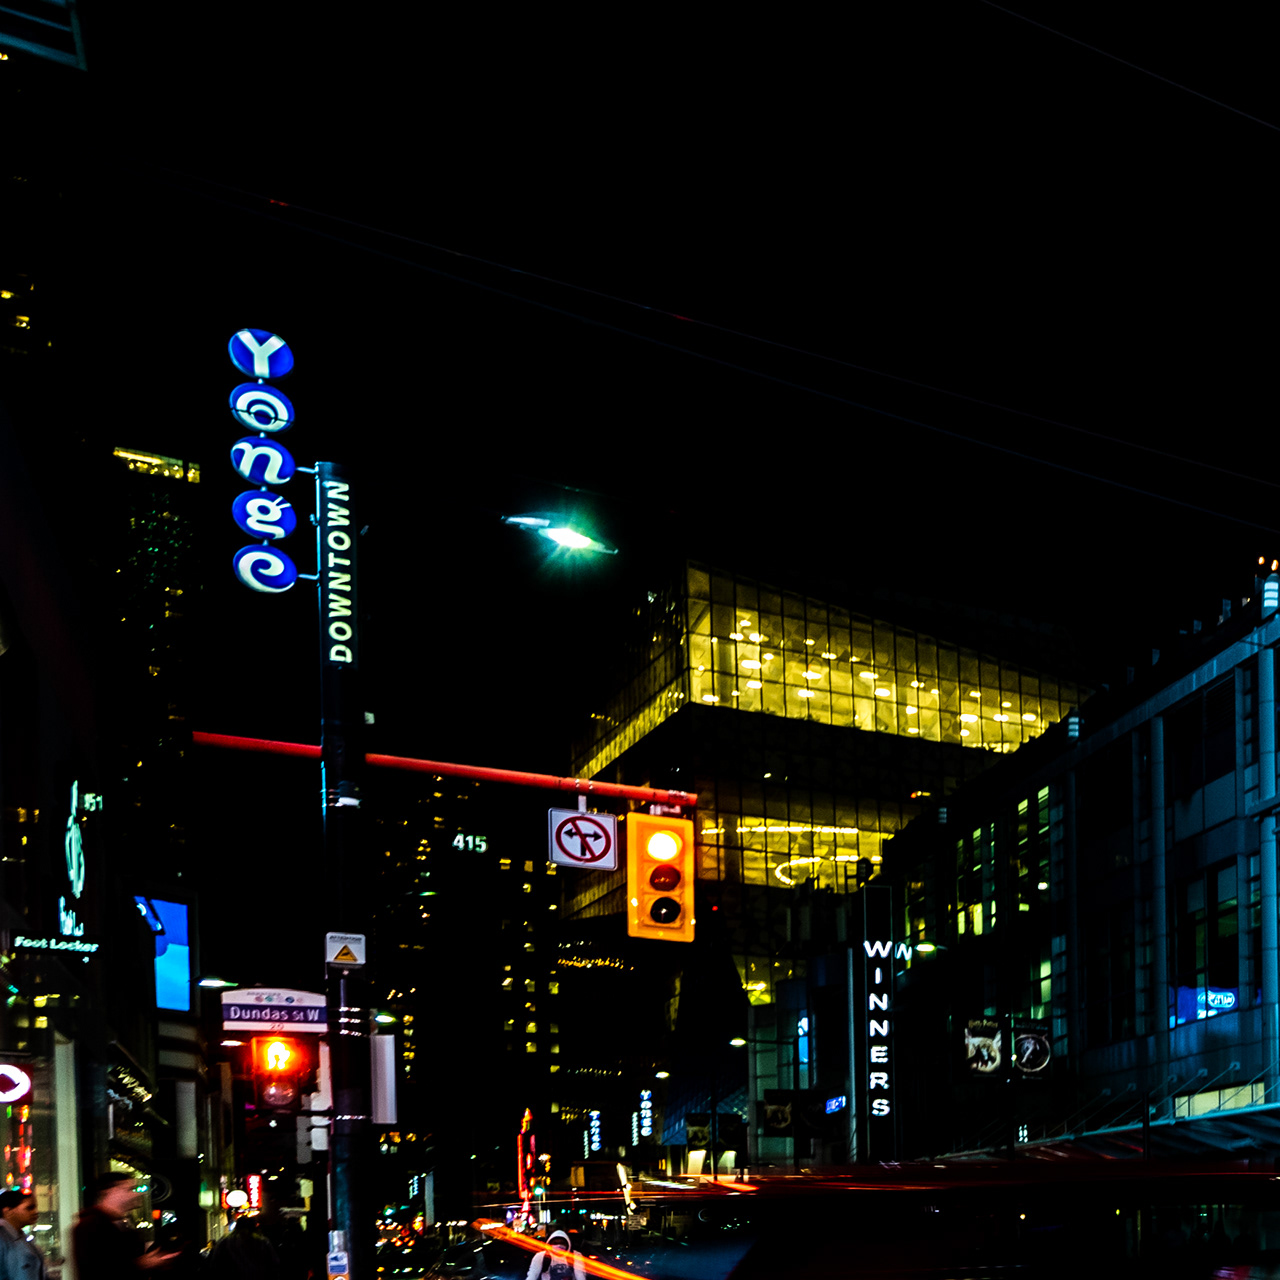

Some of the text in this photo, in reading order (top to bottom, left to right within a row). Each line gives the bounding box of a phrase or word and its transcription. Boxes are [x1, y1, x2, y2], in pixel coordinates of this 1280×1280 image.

[231, 328, 296, 594] Yonge
[327, 480, 353, 663] DOWNTOWN
[453, 834, 487, 853] 415
[14, 936, 99, 952] Foot Locker
[229, 1006, 320, 1021] Dundas St W
[864, 940, 891, 1116] WINNERS
